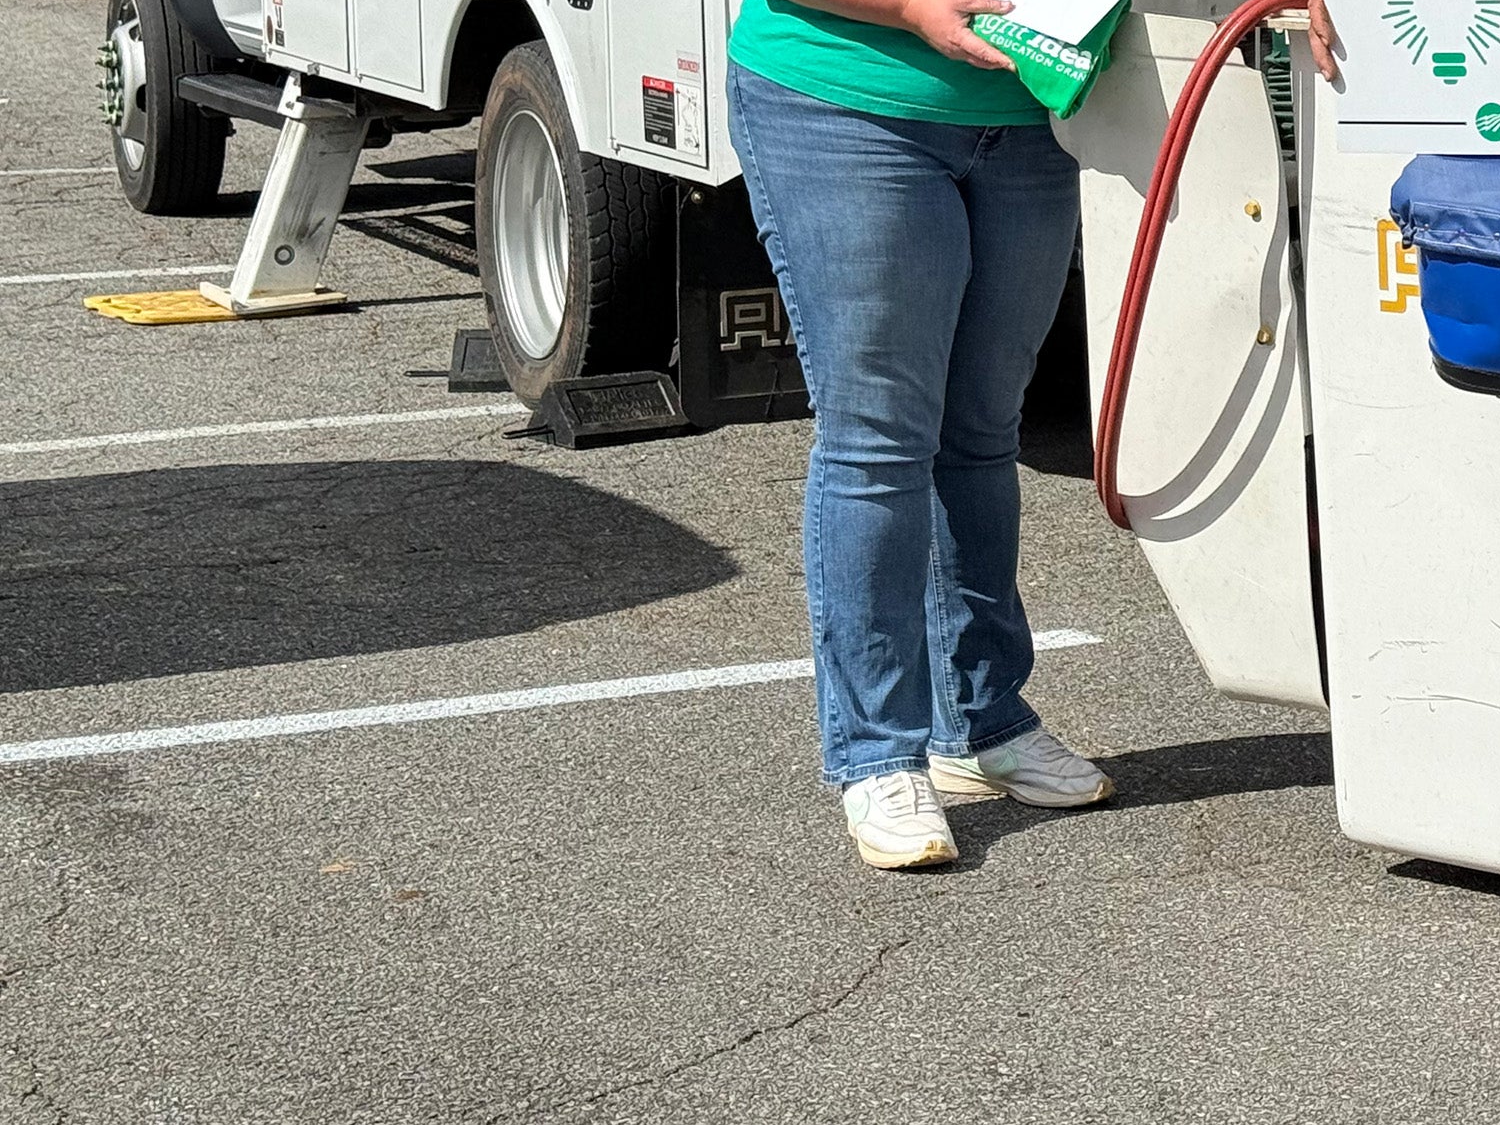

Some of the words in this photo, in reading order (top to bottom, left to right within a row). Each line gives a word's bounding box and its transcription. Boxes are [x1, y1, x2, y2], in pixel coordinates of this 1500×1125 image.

[974, 14, 1030, 40] ight
[990, 34, 1054, 67] EDUCATION
[1056, 64, 1087, 82] GRAN
[1027, 34, 1092, 72] Idea
